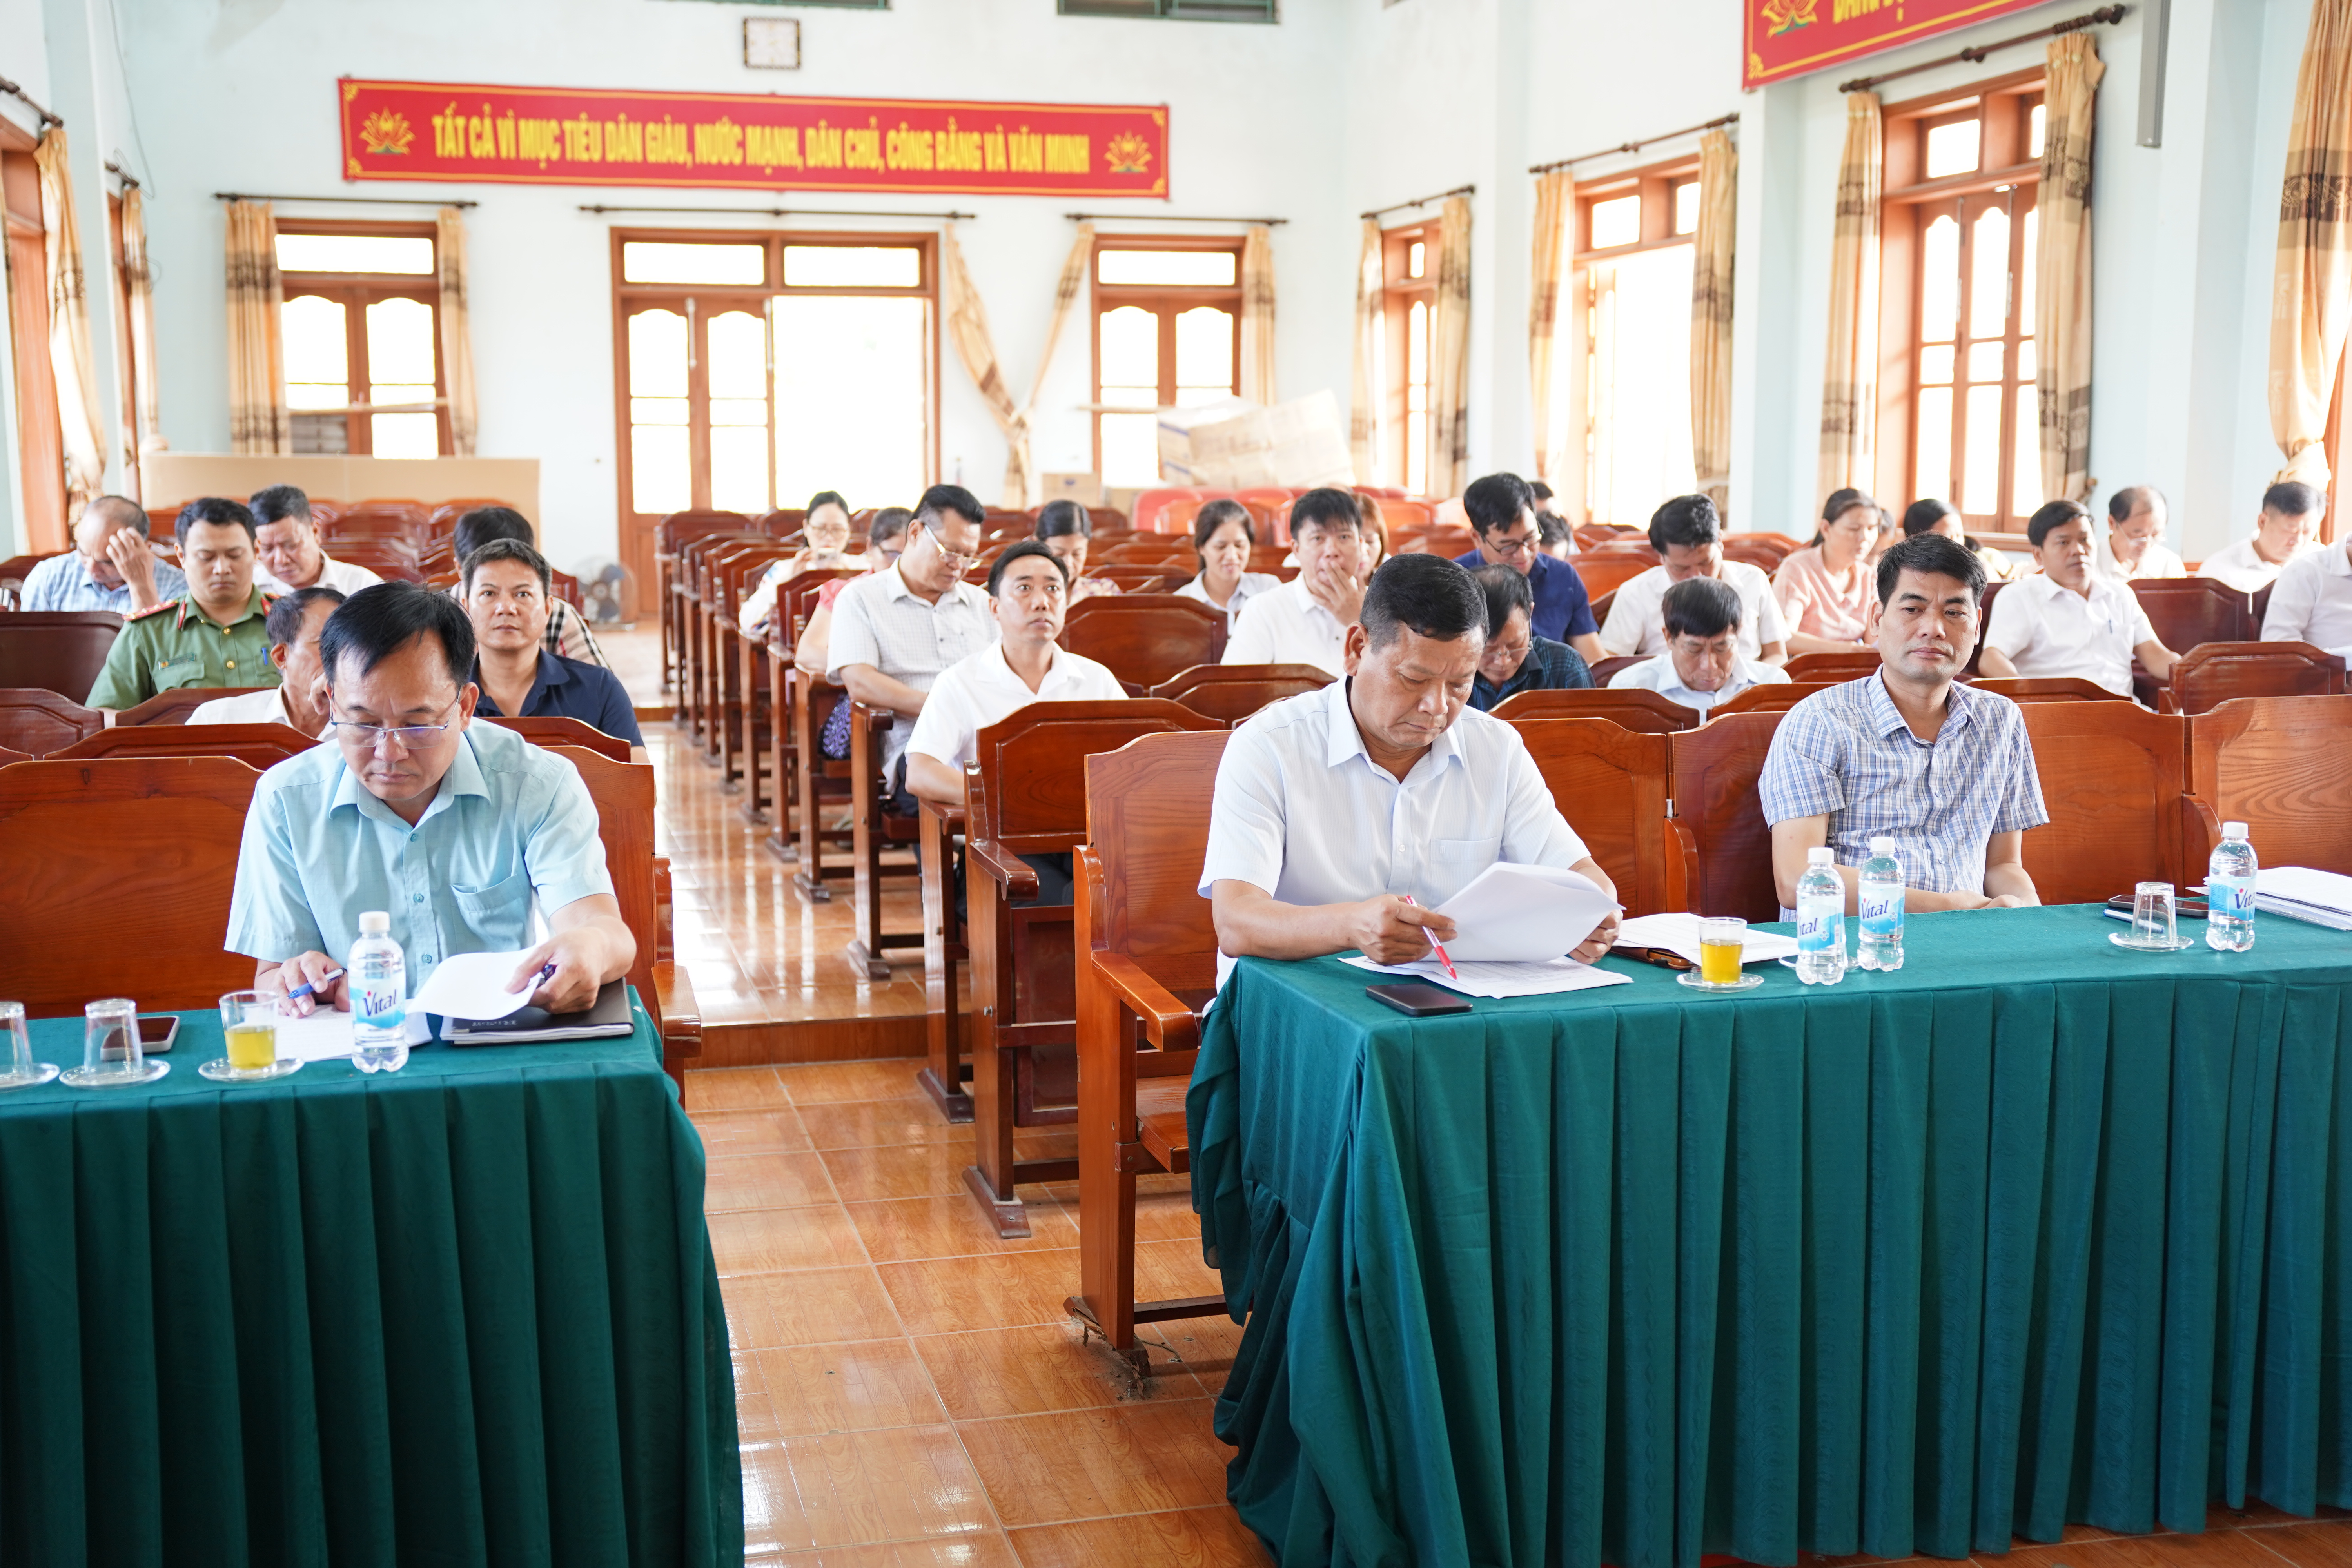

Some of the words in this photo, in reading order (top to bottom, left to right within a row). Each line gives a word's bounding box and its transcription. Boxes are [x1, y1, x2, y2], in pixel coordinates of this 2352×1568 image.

[432, 100, 466, 158] TẤT
[469, 102, 496, 159] CẢ
[495, 108, 517, 160] VÌ
[518, 118, 561, 170] MỤC
[561, 111, 604, 163] TIÊU
[604, 112, 643, 163] DÂN
[693, 115, 743, 165] NƯỚC
[805, 118, 842, 169] DÂN
[886, 121, 934, 171] CÔNG
[935, 115, 983, 172] BẰNG
[983, 123, 1008, 173] VÀ
[1007, 124, 1044, 173] VĂN
[1044, 133, 1090, 175] MINH
[1861, 898, 1889, 920] Vital
[362, 989, 397, 1017] Vital
